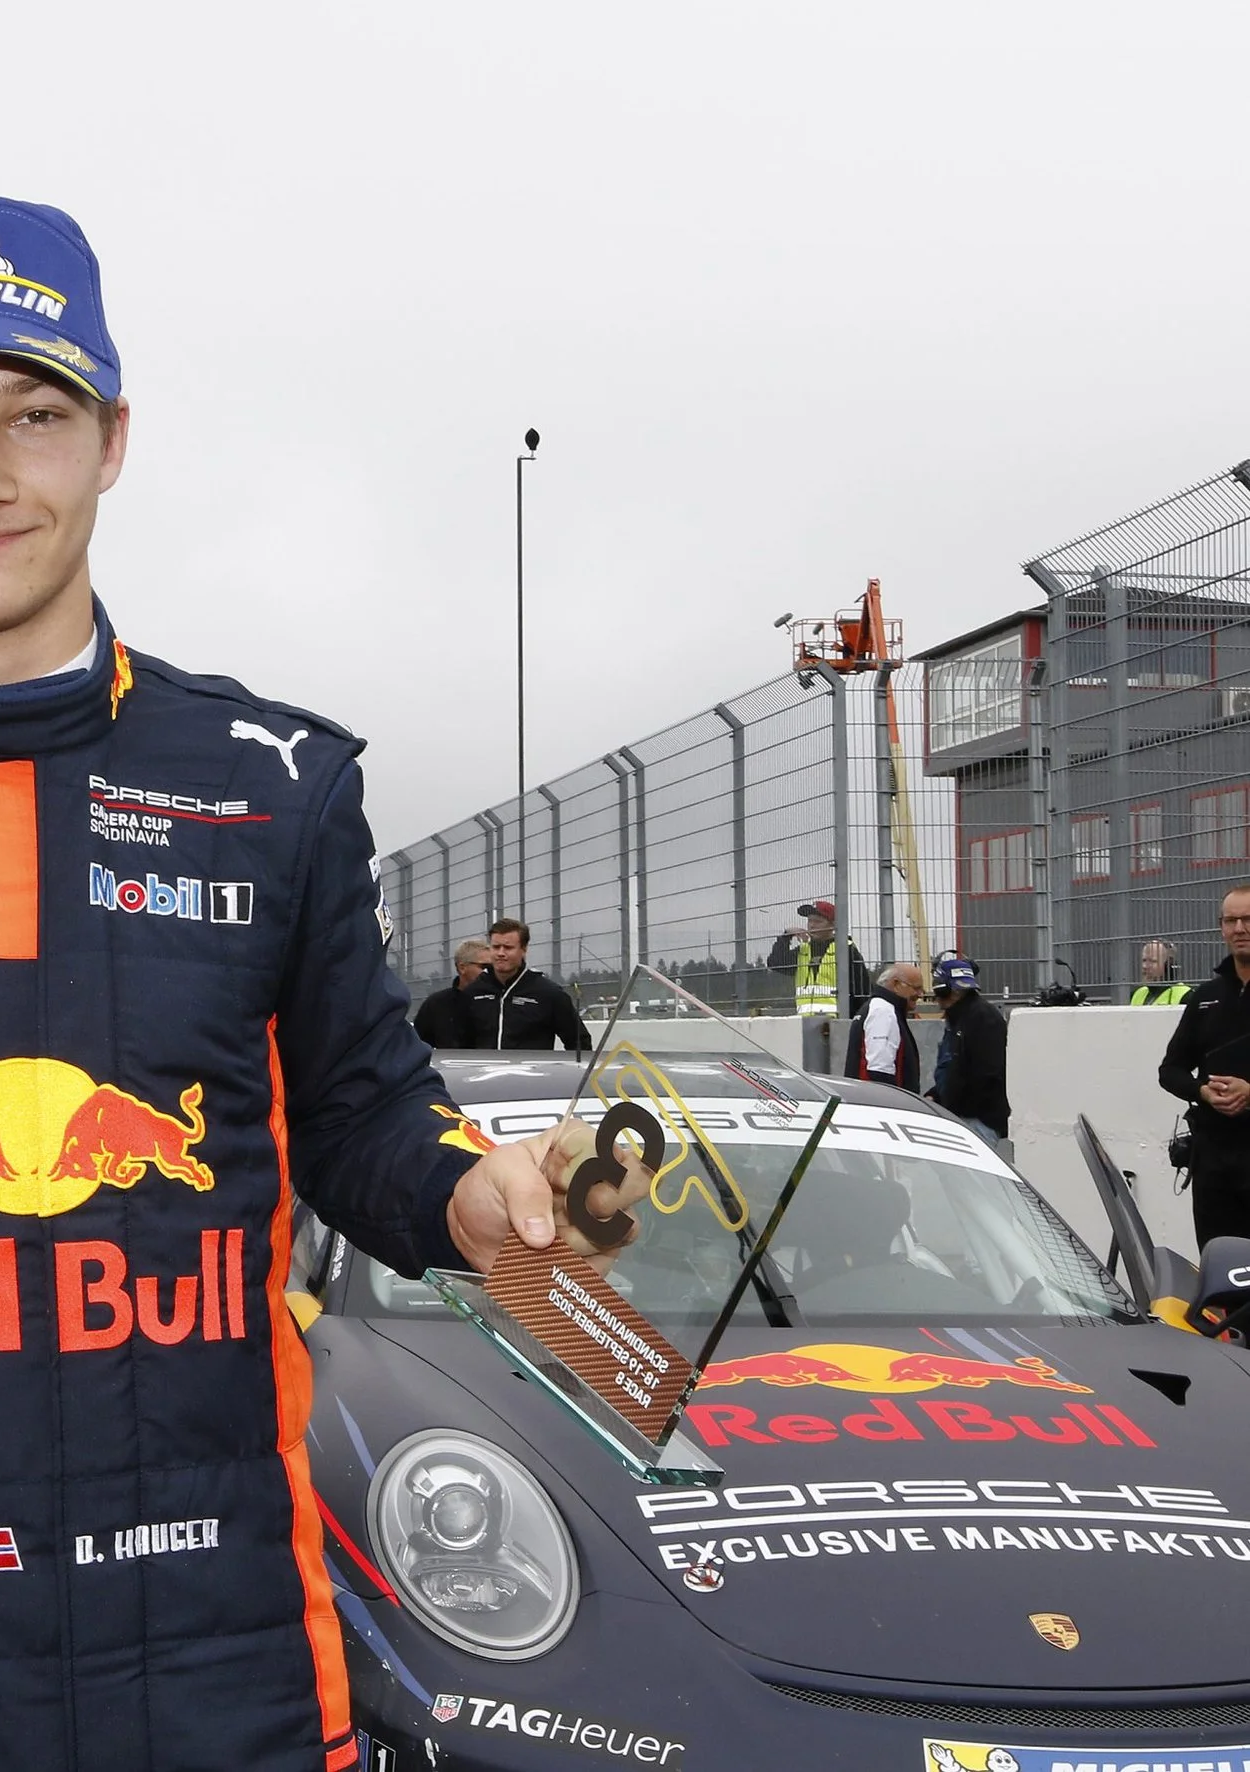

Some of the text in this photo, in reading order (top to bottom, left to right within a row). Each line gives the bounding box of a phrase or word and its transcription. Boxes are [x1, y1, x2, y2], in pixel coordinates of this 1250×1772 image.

[89, 774, 248, 816] PORSCHE
[142, 815, 172, 831] CUP
[89, 862, 202, 920] Mobil
[54, 1228, 246, 1353] Bull
[686, 1400, 1158, 1448] Red Bull
[636, 1481, 1229, 1519] PORSCHE
[75, 1518, 220, 1565] D. HAUGER
[658, 1527, 933, 1570] EXCLUSIVE
